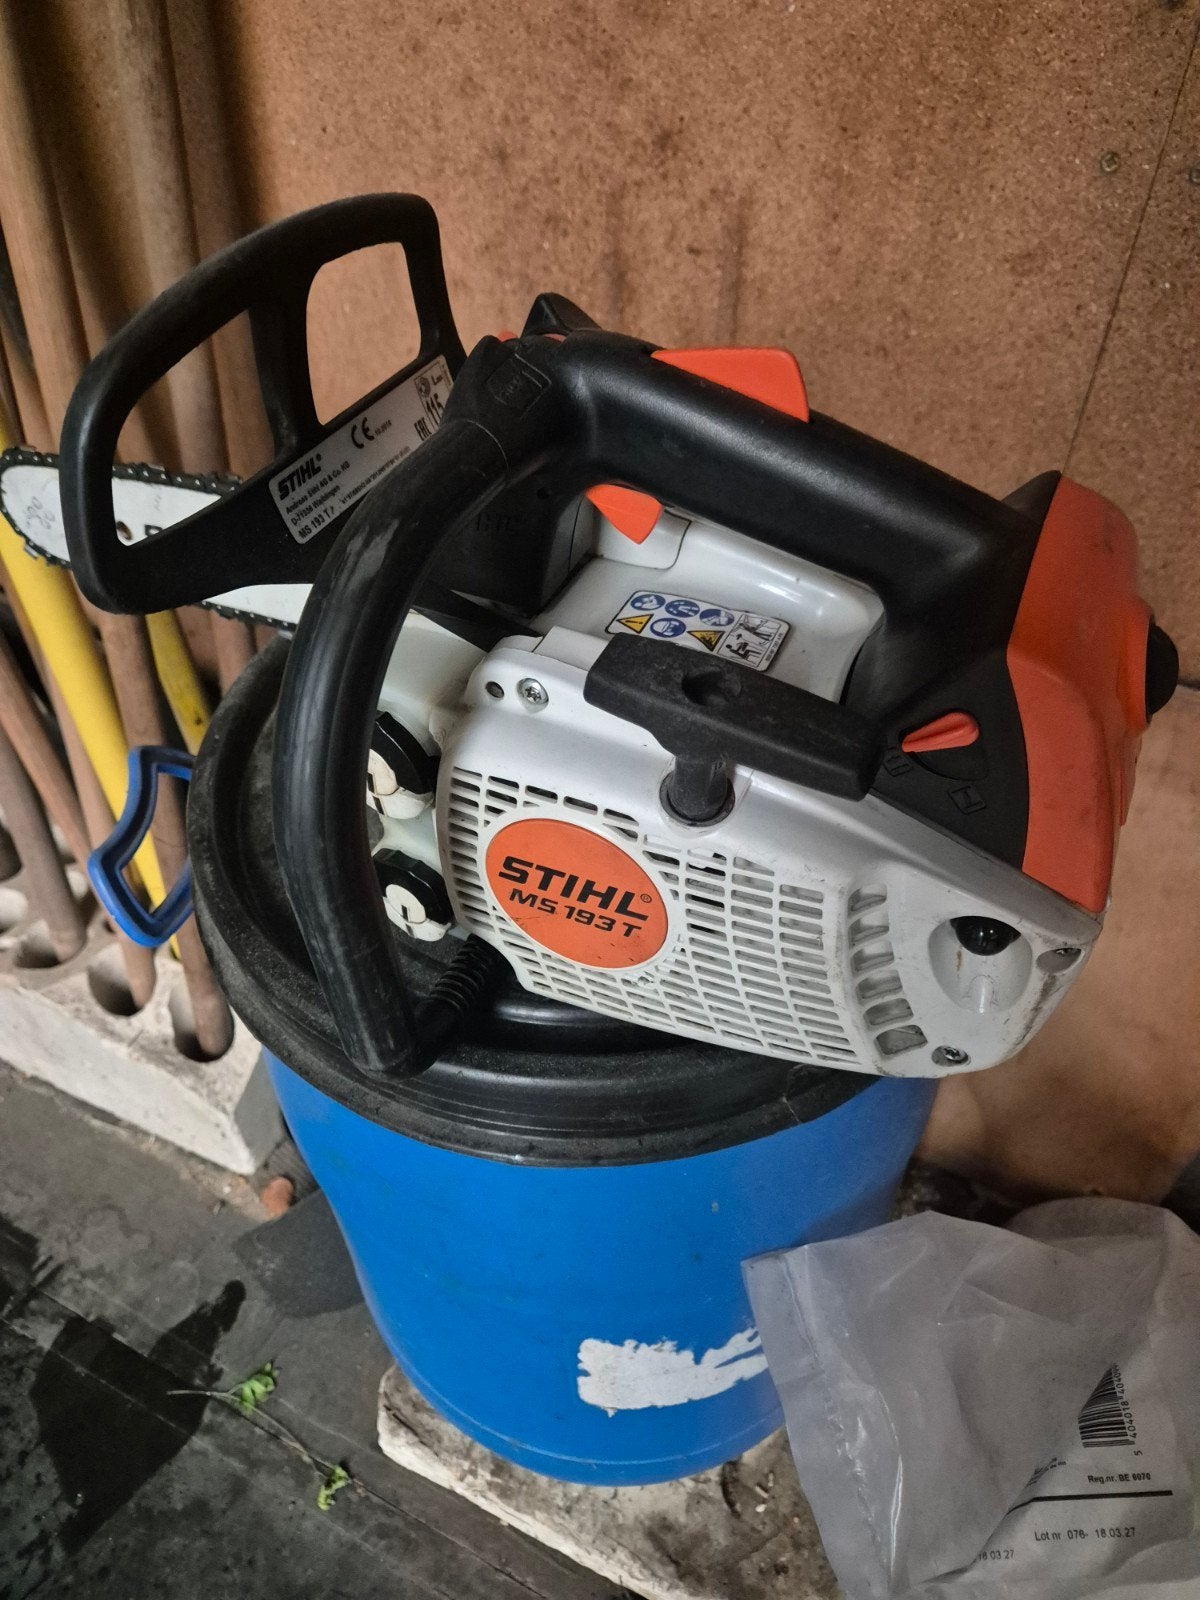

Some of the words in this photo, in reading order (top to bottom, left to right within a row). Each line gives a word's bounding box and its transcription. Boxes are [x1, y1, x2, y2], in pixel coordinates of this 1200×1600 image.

[277, 457, 322, 501] STIHL
[298, 524, 313, 540] MS
[311, 513, 325, 529] 193
[509, 888, 559, 915] MS
[563, 905, 617, 932] 193
[622, 921, 642, 938] T
[1034, 1531, 1050, 1541] Lot
[1051, 1532, 1061, 1541] nr
